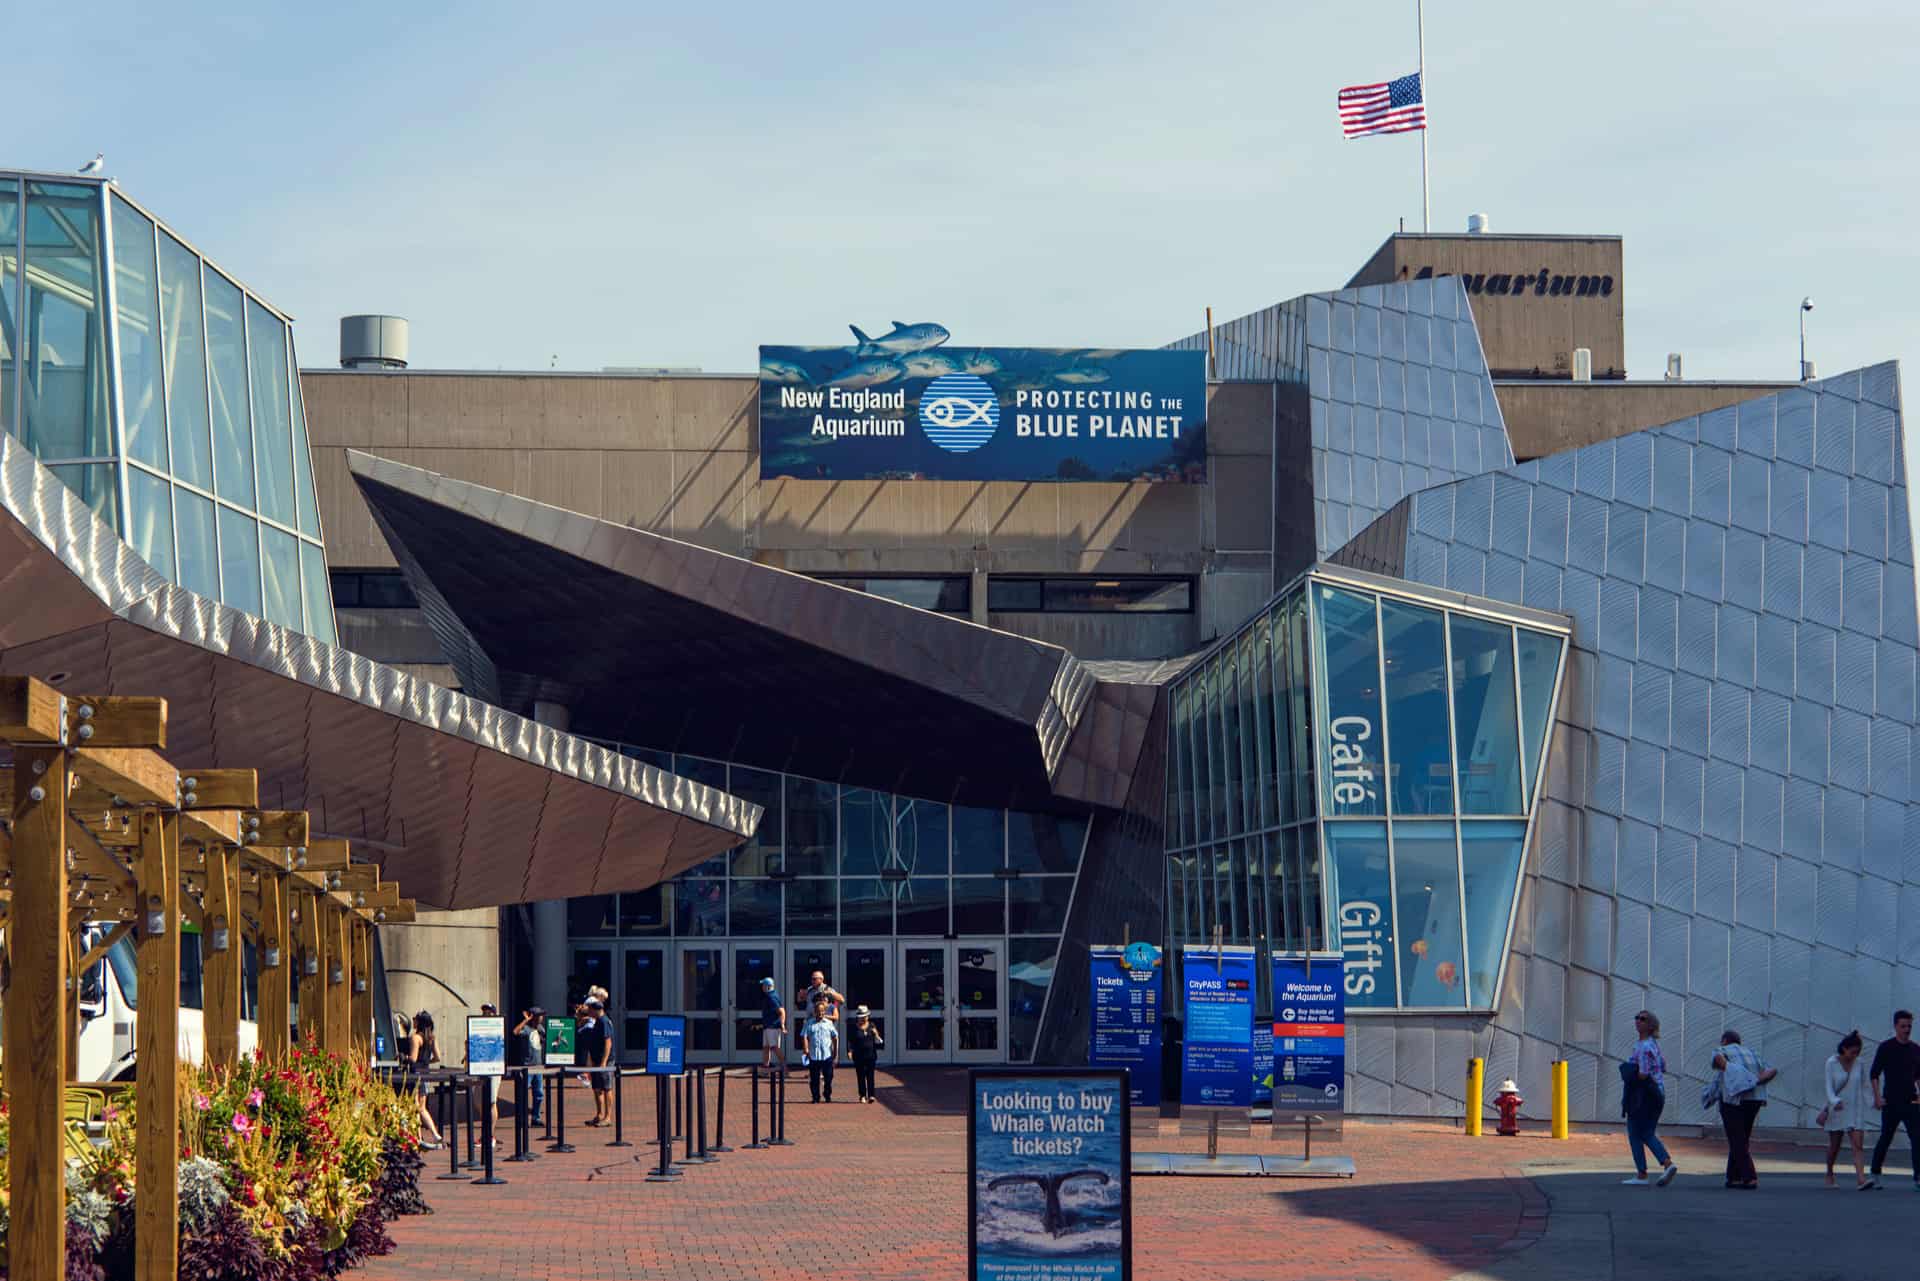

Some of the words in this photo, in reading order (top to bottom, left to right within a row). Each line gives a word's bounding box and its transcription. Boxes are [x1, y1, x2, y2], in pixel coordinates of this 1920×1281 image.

[1414, 265, 1615, 298] uarium
[781, 387, 826, 409] New
[830, 387, 905, 415] England
[1016, 390, 1154, 409] PROTECTING
[1160, 398, 1183, 410] THE
[811, 414, 905, 437] Aquarium
[1016, 415, 1079, 438] BLUE
[1089, 415, 1183, 439] PLANET
[1331, 715, 1377, 805] Café
[1340, 900, 1383, 996] Gifts
[1096, 976, 1124, 986] Tickets
[1189, 980, 1222, 990] CityPASS
[1286, 983, 1322, 993] Welcome
[1324, 983, 1332, 992] to
[1282, 992, 1295, 1001] the
[1296, 992, 1337, 1003] Aquarium!
[982, 1091, 1052, 1113] Looking
[1058, 1092, 1075, 1110] to
[1080, 1092, 1113, 1113] buy
[990, 1114, 1045, 1132] Whale
[1049, 1115, 1105, 1132] Watch
[1011, 1137, 1083, 1155] tickets?
